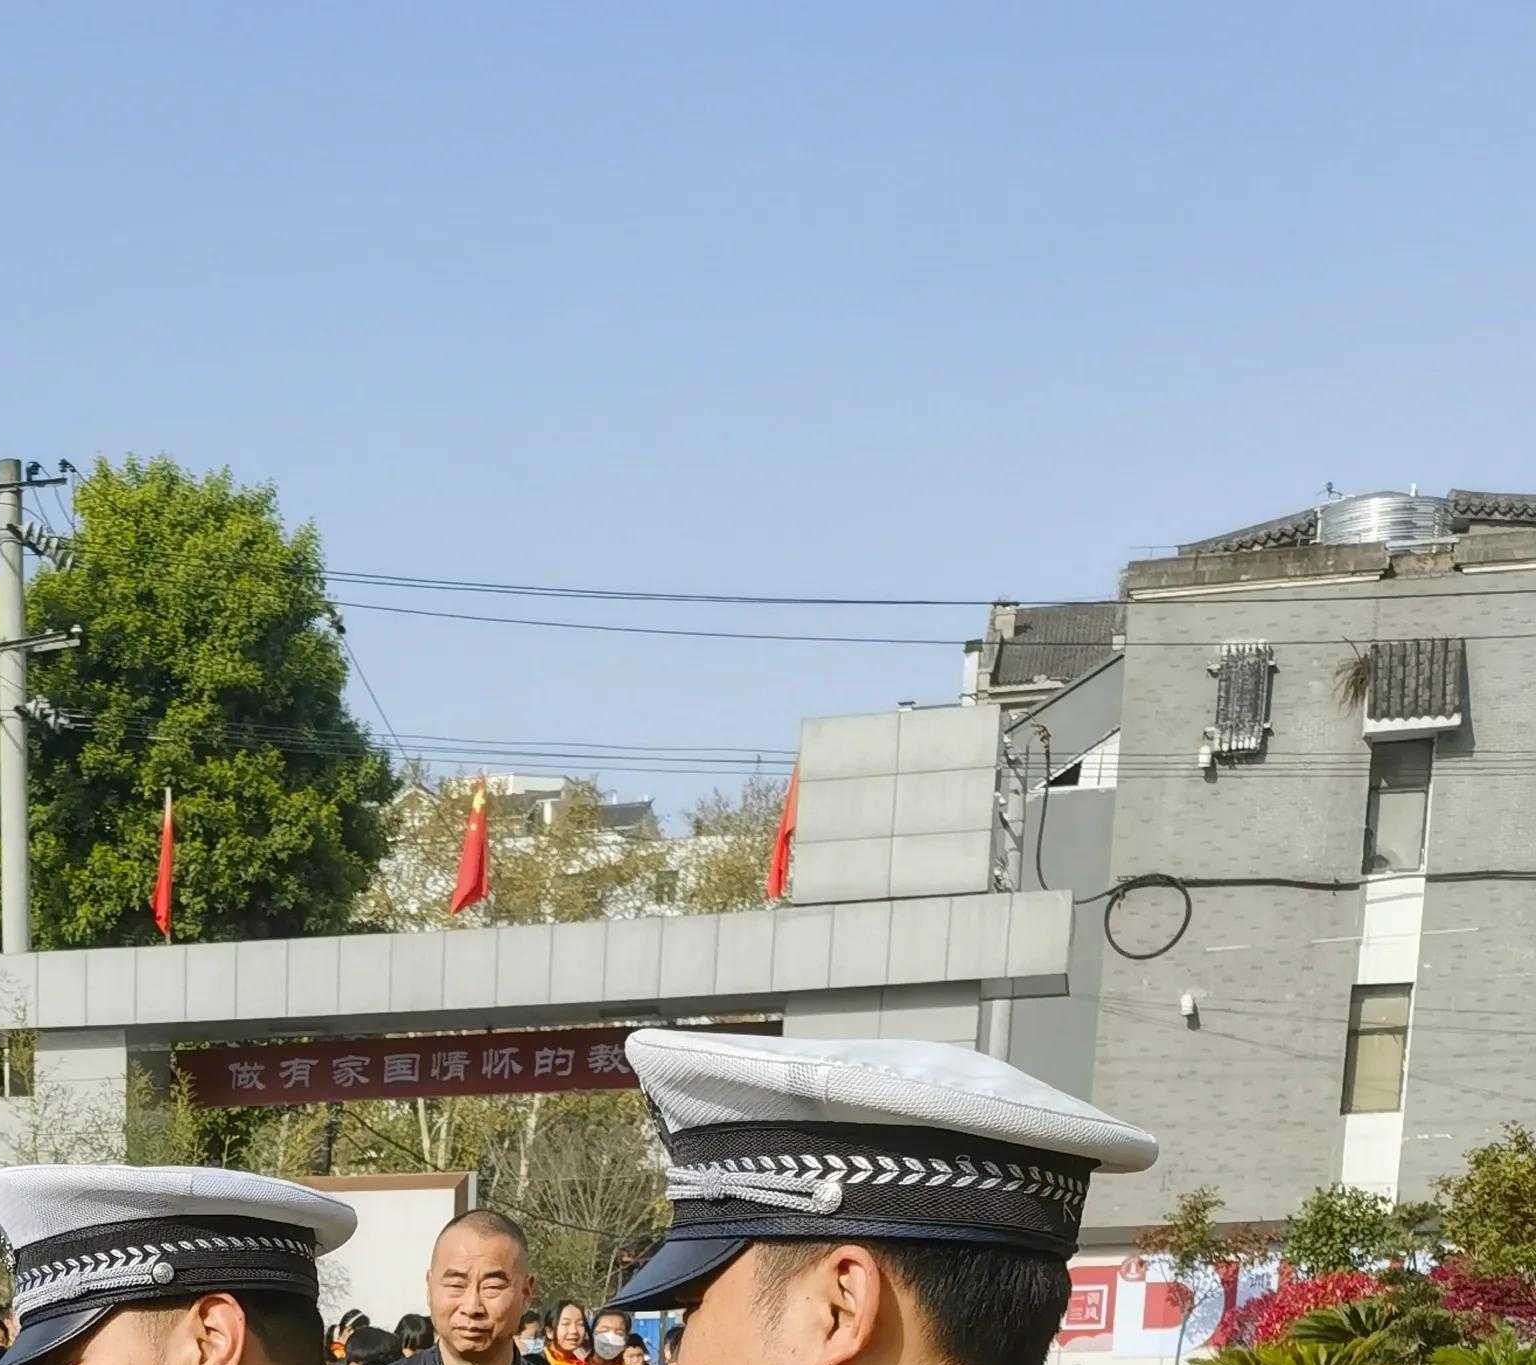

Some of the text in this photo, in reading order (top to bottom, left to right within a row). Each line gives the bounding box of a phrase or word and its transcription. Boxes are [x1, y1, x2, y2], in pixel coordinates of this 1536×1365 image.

[228, 1042, 631, 1091] 做有家国情怀的教
